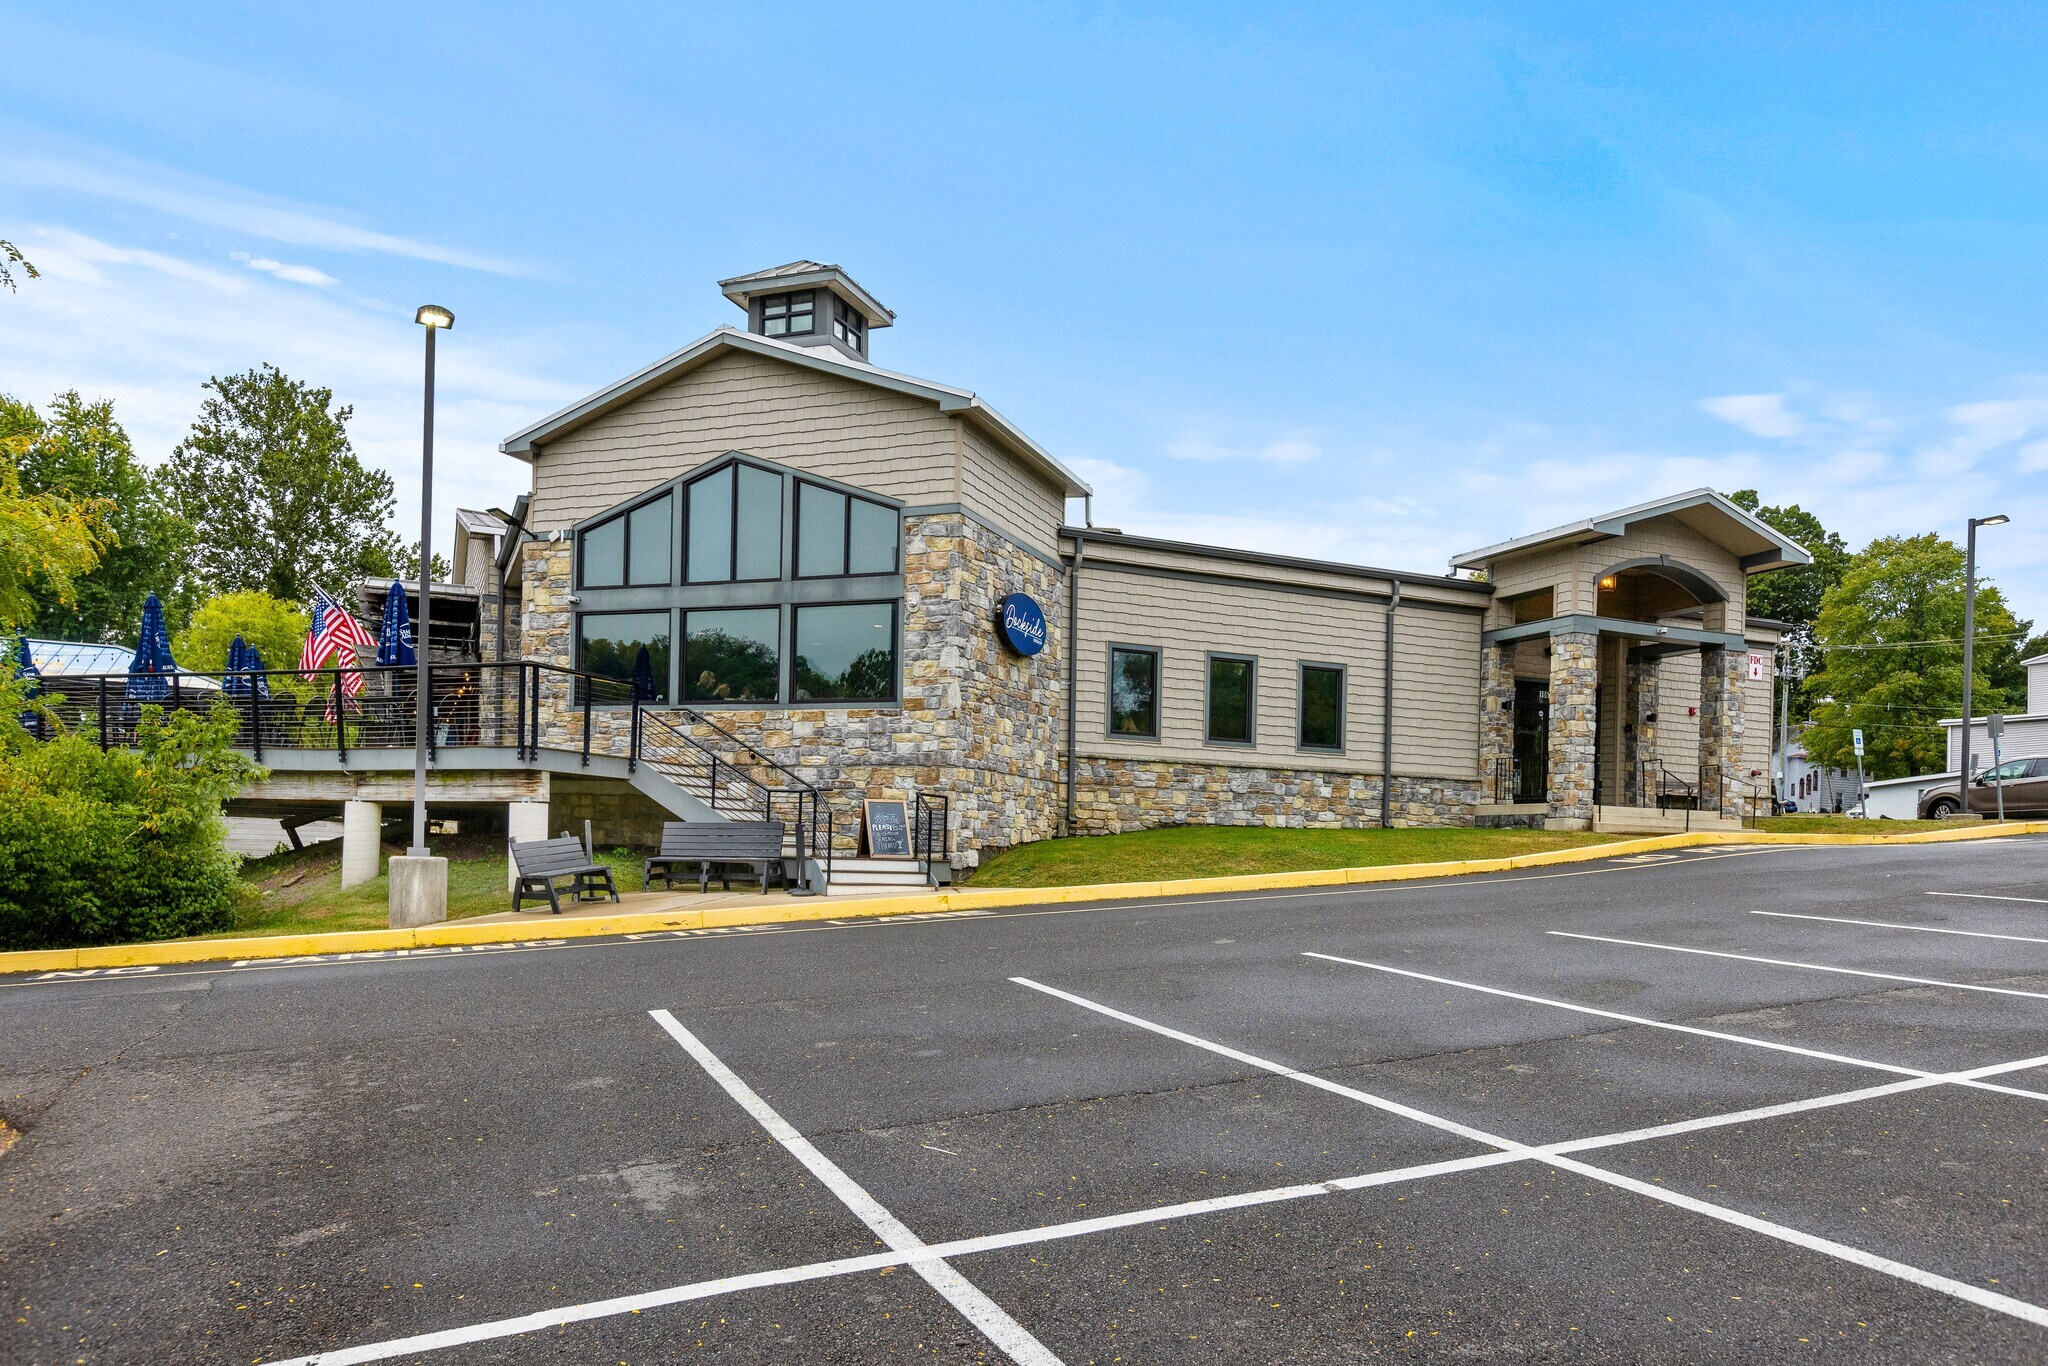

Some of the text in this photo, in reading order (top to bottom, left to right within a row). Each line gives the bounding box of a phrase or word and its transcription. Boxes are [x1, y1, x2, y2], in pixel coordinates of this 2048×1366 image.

[1006, 604, 1044, 637] Dockside
[1750, 655, 1763, 666] FDC
[26, 965, 160, 981] NO
[231, 940, 568, 967] PARKING
